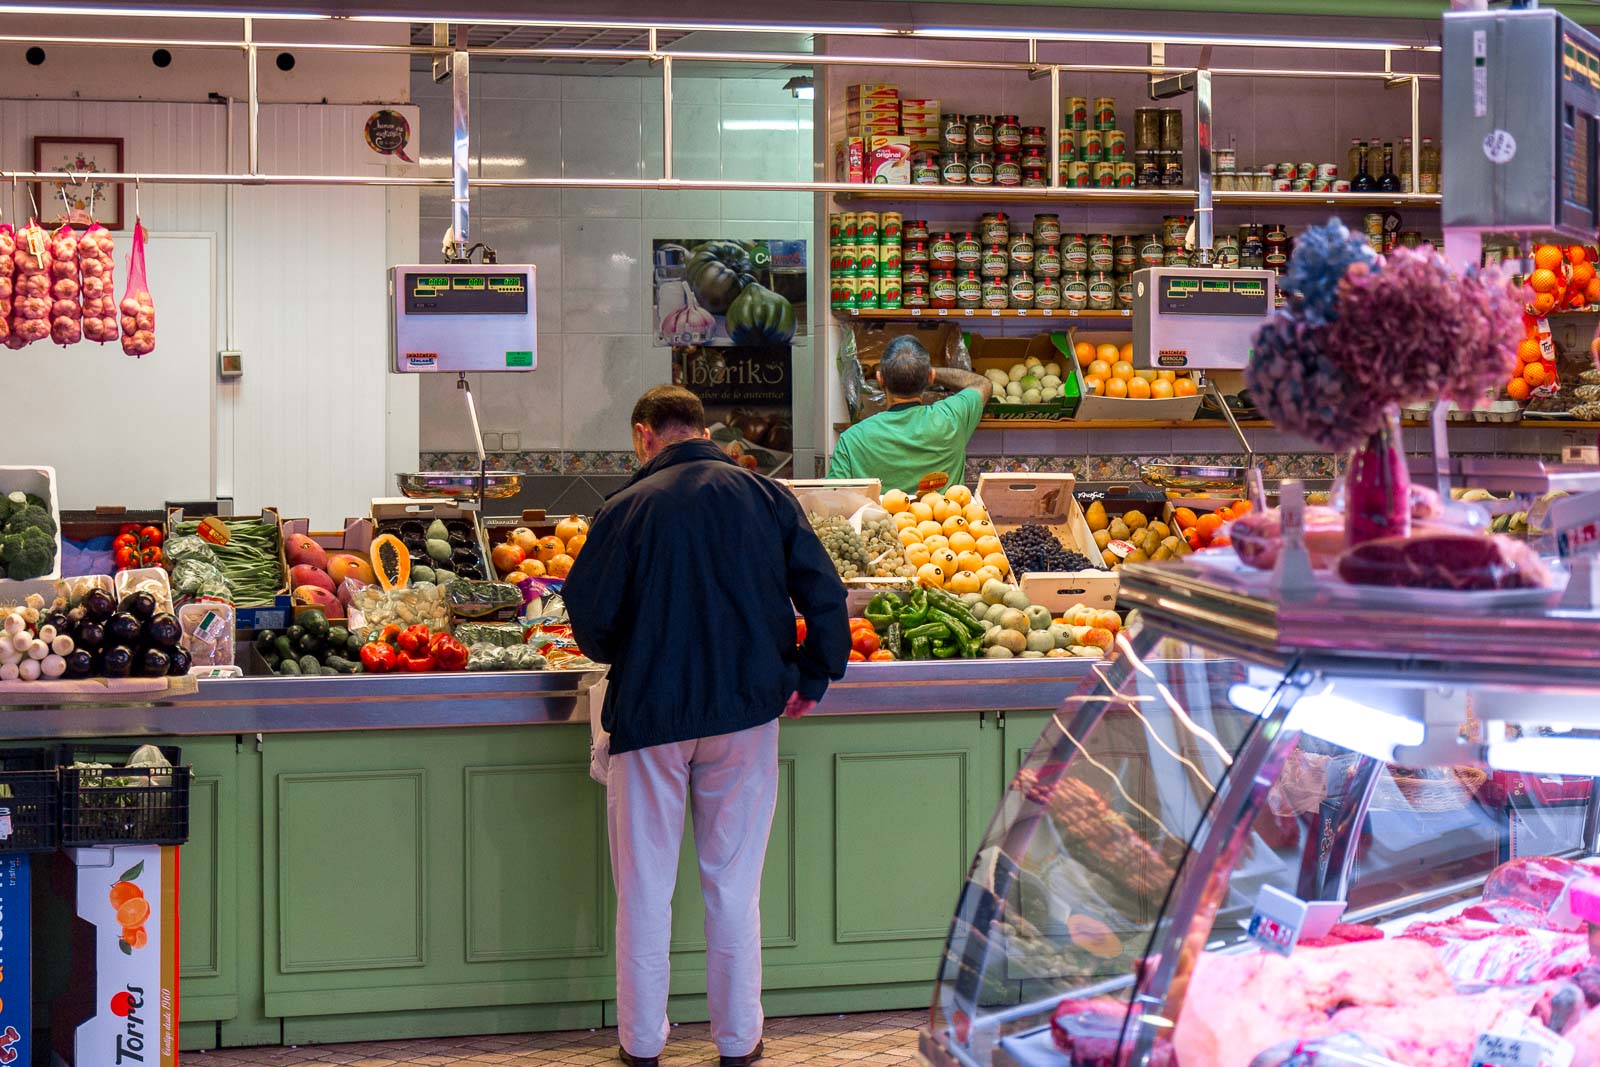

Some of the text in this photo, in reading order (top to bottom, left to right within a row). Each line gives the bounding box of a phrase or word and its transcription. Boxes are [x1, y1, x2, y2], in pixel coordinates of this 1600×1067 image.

[698, 391, 718, 399] abor
[162, 988, 171, 1011] 1960
[115, 983, 144, 1065] Torres
